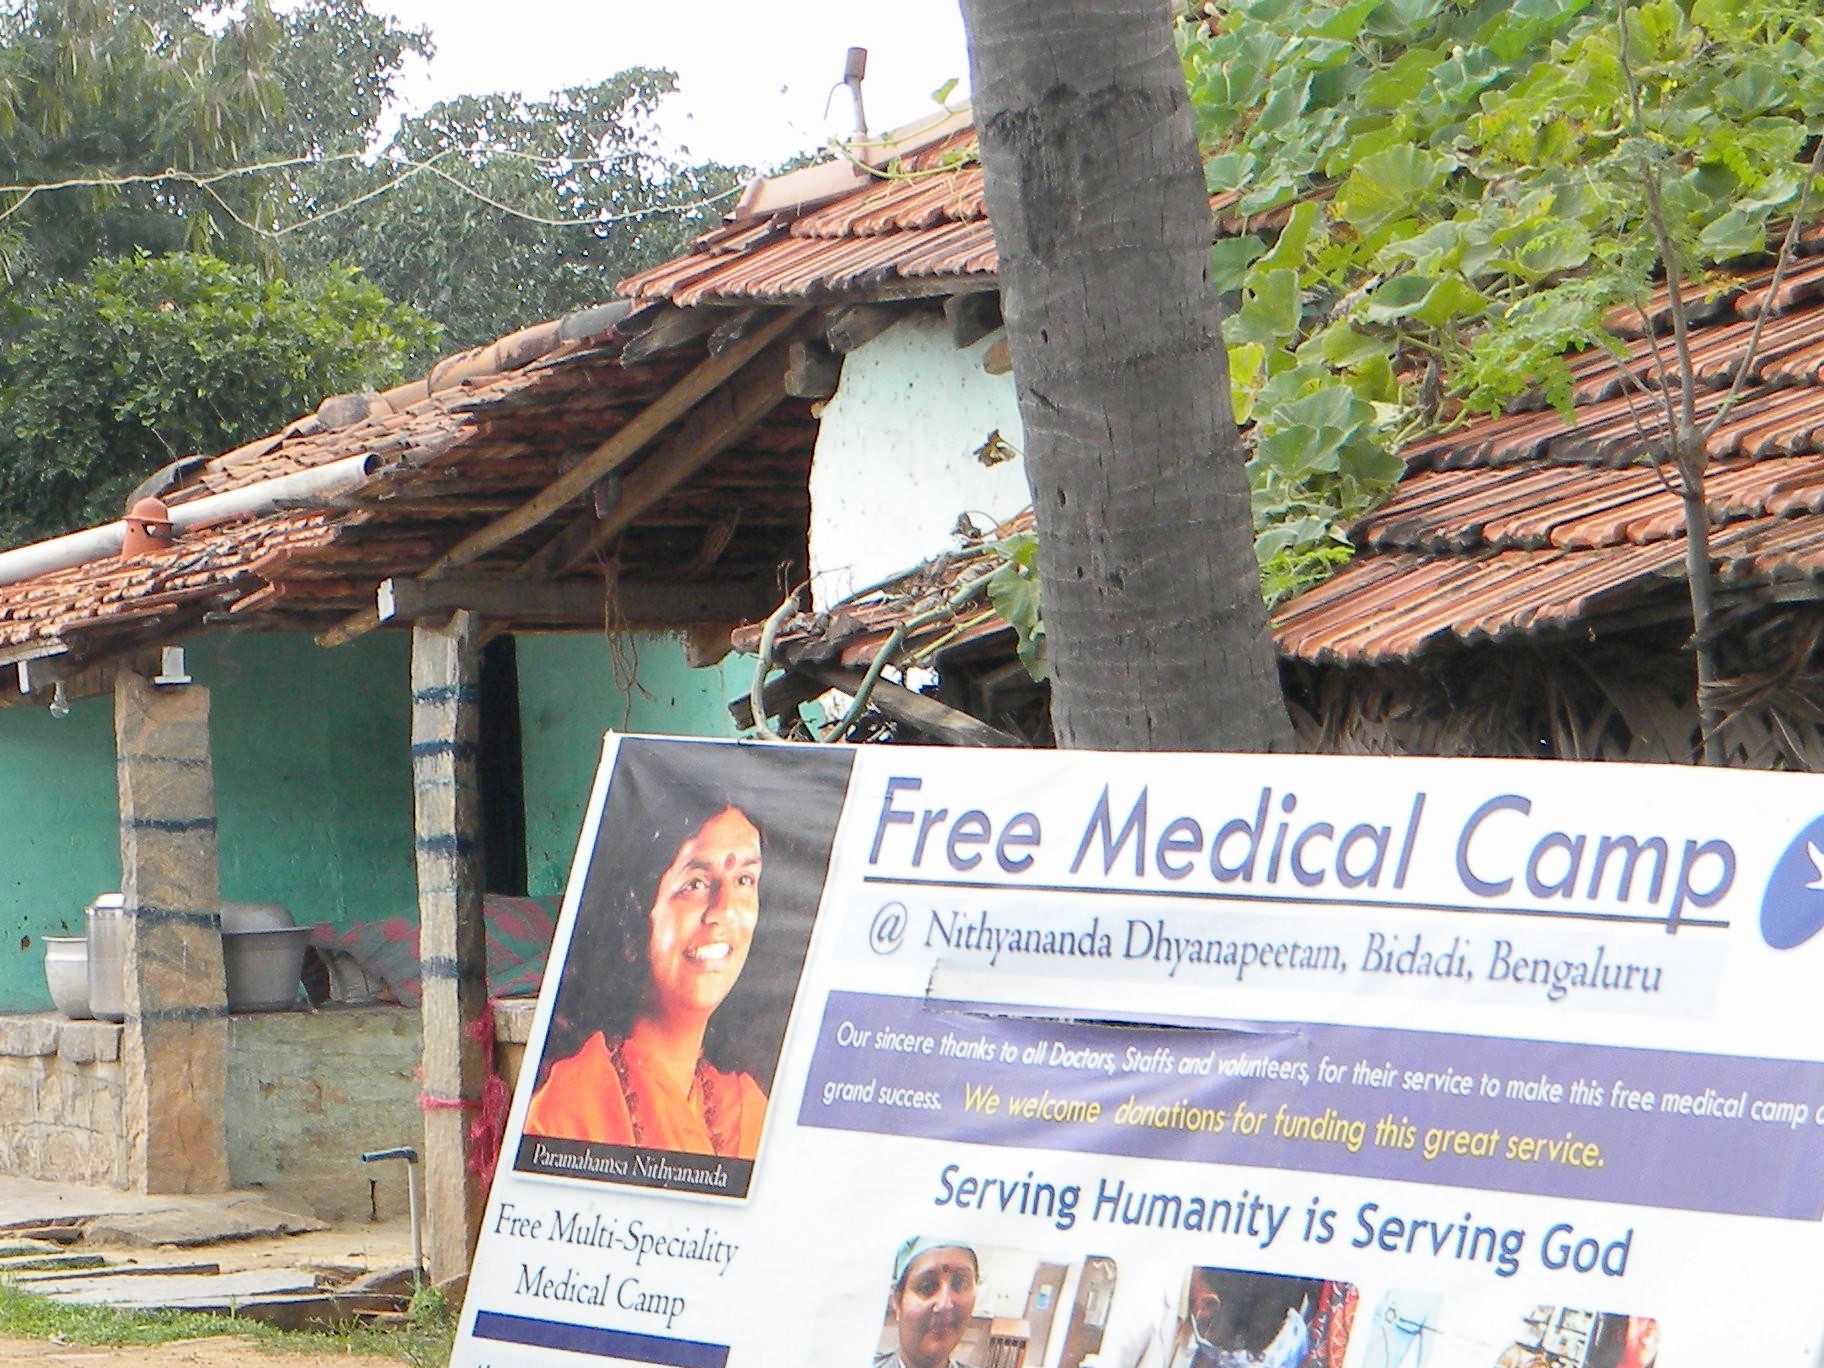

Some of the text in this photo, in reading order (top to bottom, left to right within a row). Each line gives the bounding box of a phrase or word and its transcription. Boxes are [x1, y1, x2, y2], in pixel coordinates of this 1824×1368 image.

[868, 776, 1736, 934] Free Medical Camp
[869, 901, 1663, 1001] @ Nithyananda Dhyanapeetam, Bidadi, Bengaluru
[836, 1020, 871, 1047] Our
[875, 1026, 933, 1054] sincere
[939, 1032, 995, 1063] thanks
[999, 1043, 1019, 1063] to
[1022, 1041, 1048, 1066] all
[1049, 1042, 1116, 1075] Doctors,
[1122, 1046, 1174, 1074] Staffs
[1177, 1051, 1214, 1076] and
[1218, 1053, 1310, 1086] volunteers,
[1317, 1056, 1345, 1083] for
[1352, 1059, 1397, 1089] their
[1401, 1067, 1473, 1096] service
[1479, 1073, 1501, 1098] to
[1506, 1074, 1563, 1103] make
[1569, 1079, 1604, 1108] this
[1610, 1080, 1655, 1112] free
[1661, 1088, 1748, 1119] medical
[1750, 1099, 1808, 1130] camp
[532, 1143, 728, 1188] Paramahamsa Nithyananda
[823, 1078, 1605, 1168] grand success. We welcome donations for funding this great service.
[493, 1202, 741, 1277] Free Multi-Speciality
[934, 1163, 1635, 1278] Serving Humanity is Serving God
[514, 1263, 685, 1329] Medical Camp
